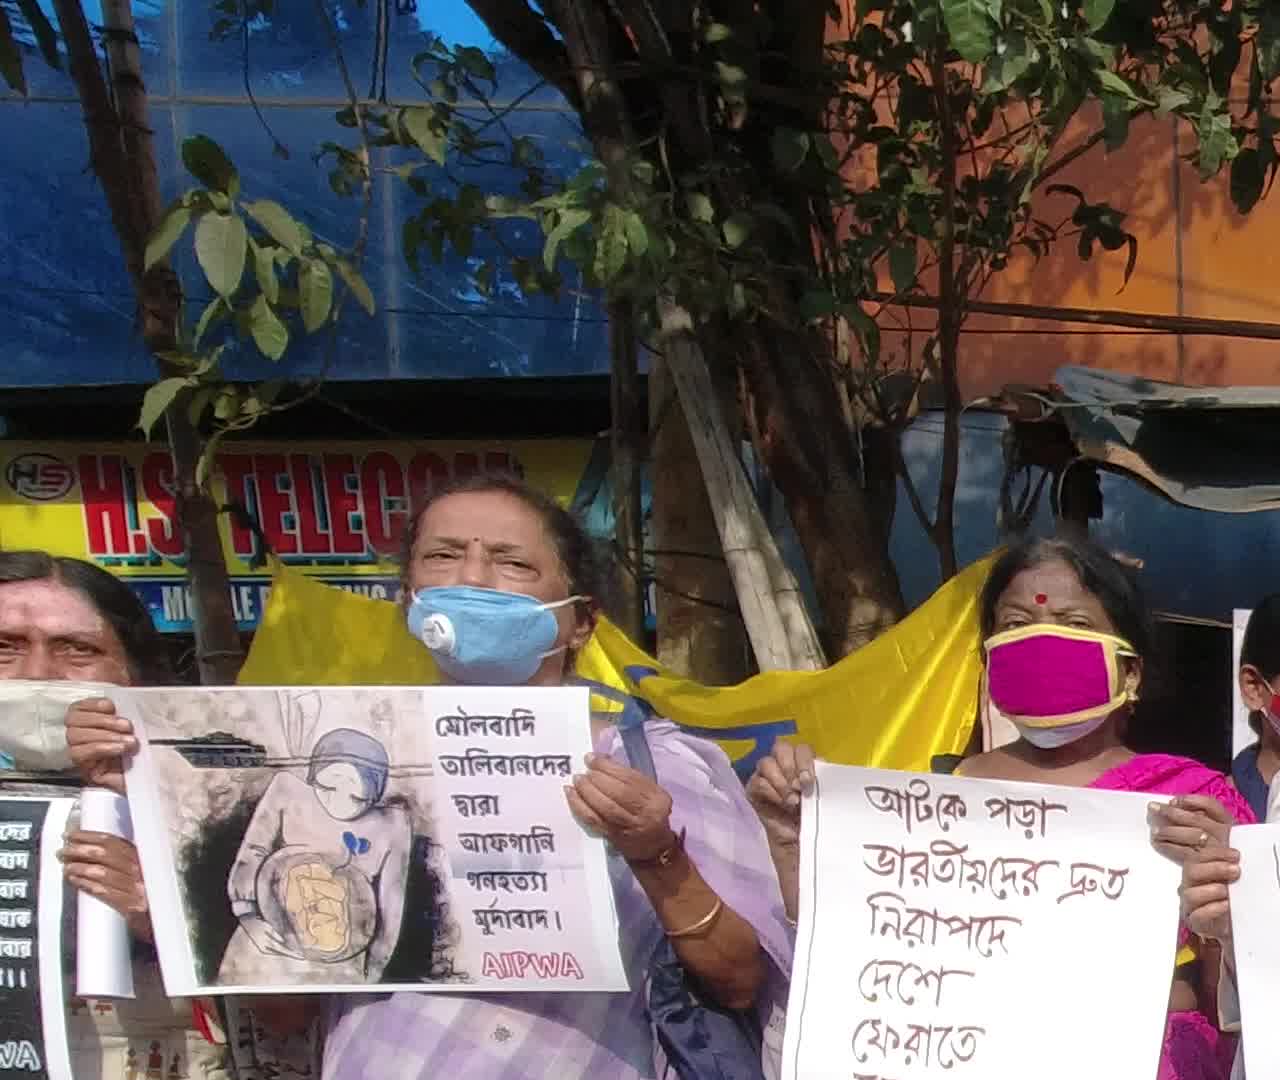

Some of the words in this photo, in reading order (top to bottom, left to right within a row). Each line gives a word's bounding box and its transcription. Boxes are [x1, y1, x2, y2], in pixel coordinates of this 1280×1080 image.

[435, 706, 535, 737] মৌলবাদি
[438, 748, 571, 777] তালিবানদের
[451, 795, 499, 817] দ্বারা
[865, 779, 967, 833] আটকে
[985, 800, 1068, 838] পড়া
[458, 826, 555, 853] আফগানি
[862, 841, 1059, 900] ভারতীয়দের
[1055, 862, 1130, 905] দ্রুত
[867, 892, 1022, 958] নিরাপদে
[482, 952, 584, 980] AIPWA
[857, 958, 976, 1008] দেশে
[851, 1018, 987, 1070] ফেরাতে
